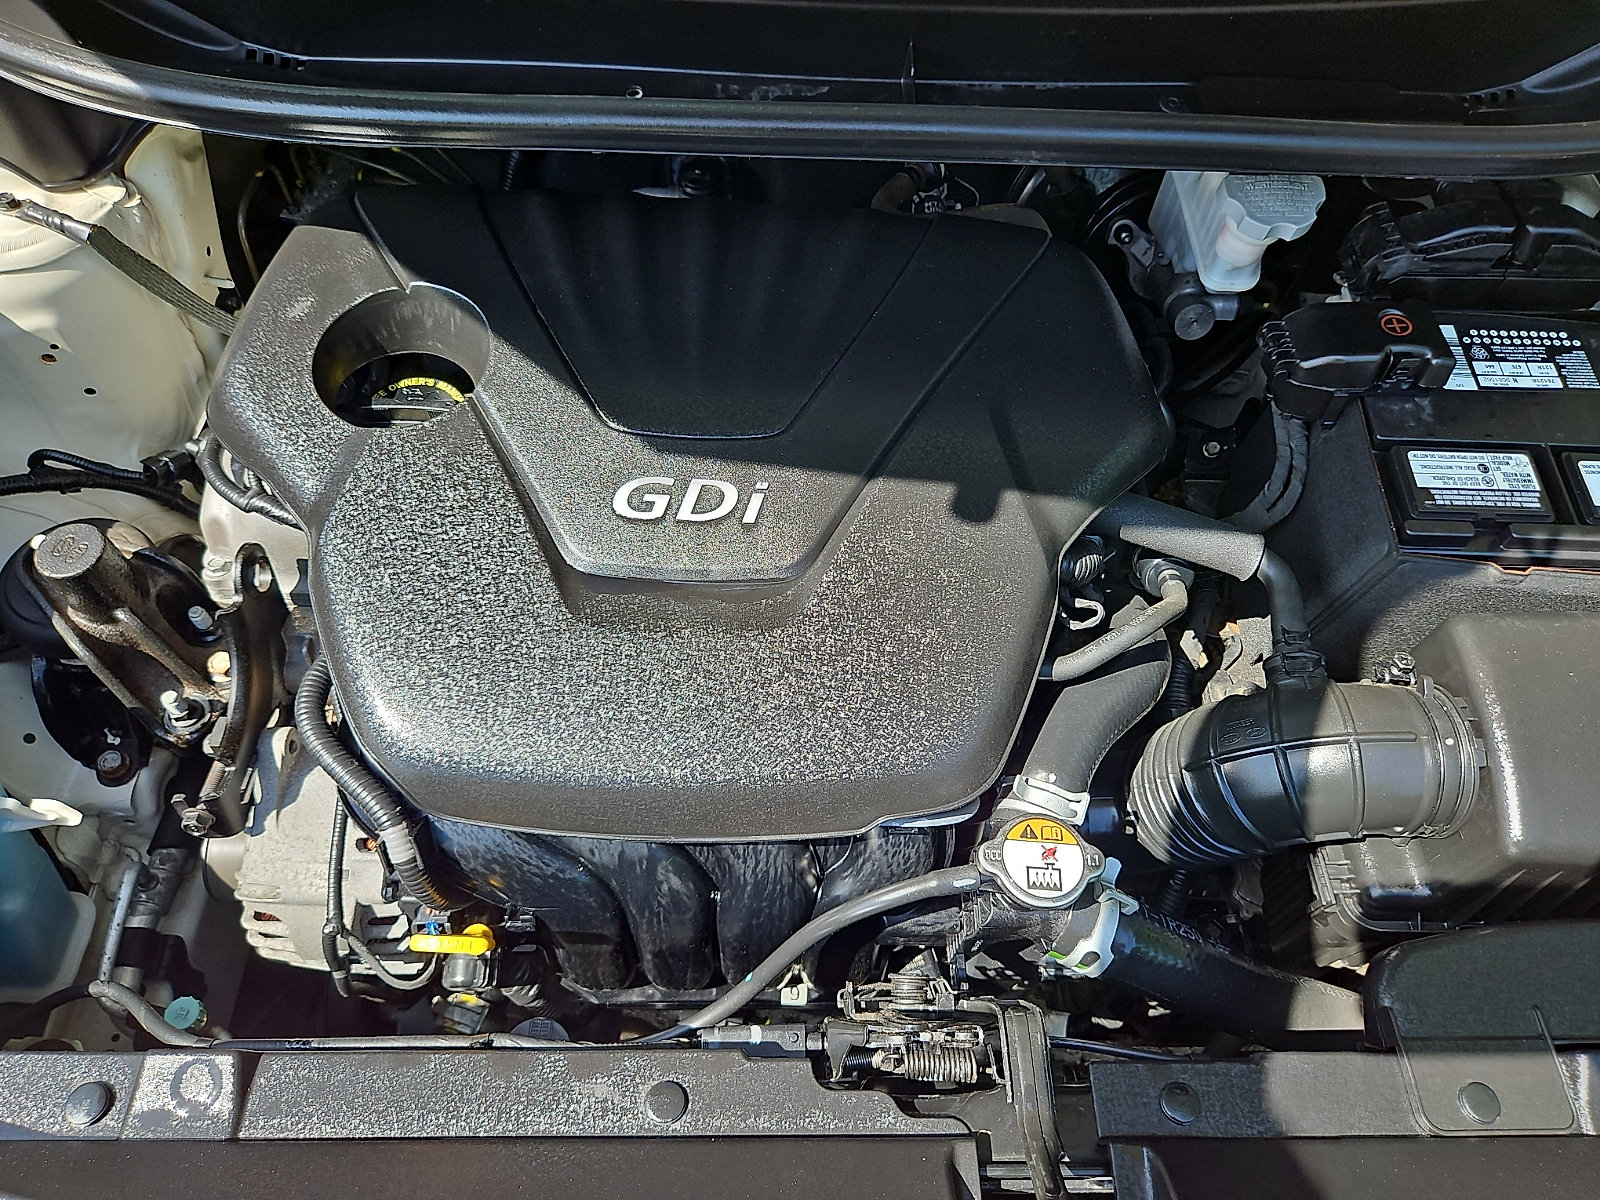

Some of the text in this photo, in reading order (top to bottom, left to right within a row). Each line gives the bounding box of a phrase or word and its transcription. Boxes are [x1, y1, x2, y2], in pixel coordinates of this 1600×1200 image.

[388, 377, 436, 392] OWNER'S
[612, 476, 770, 525] GDi
[1085, 854, 1100, 866] 1.1
